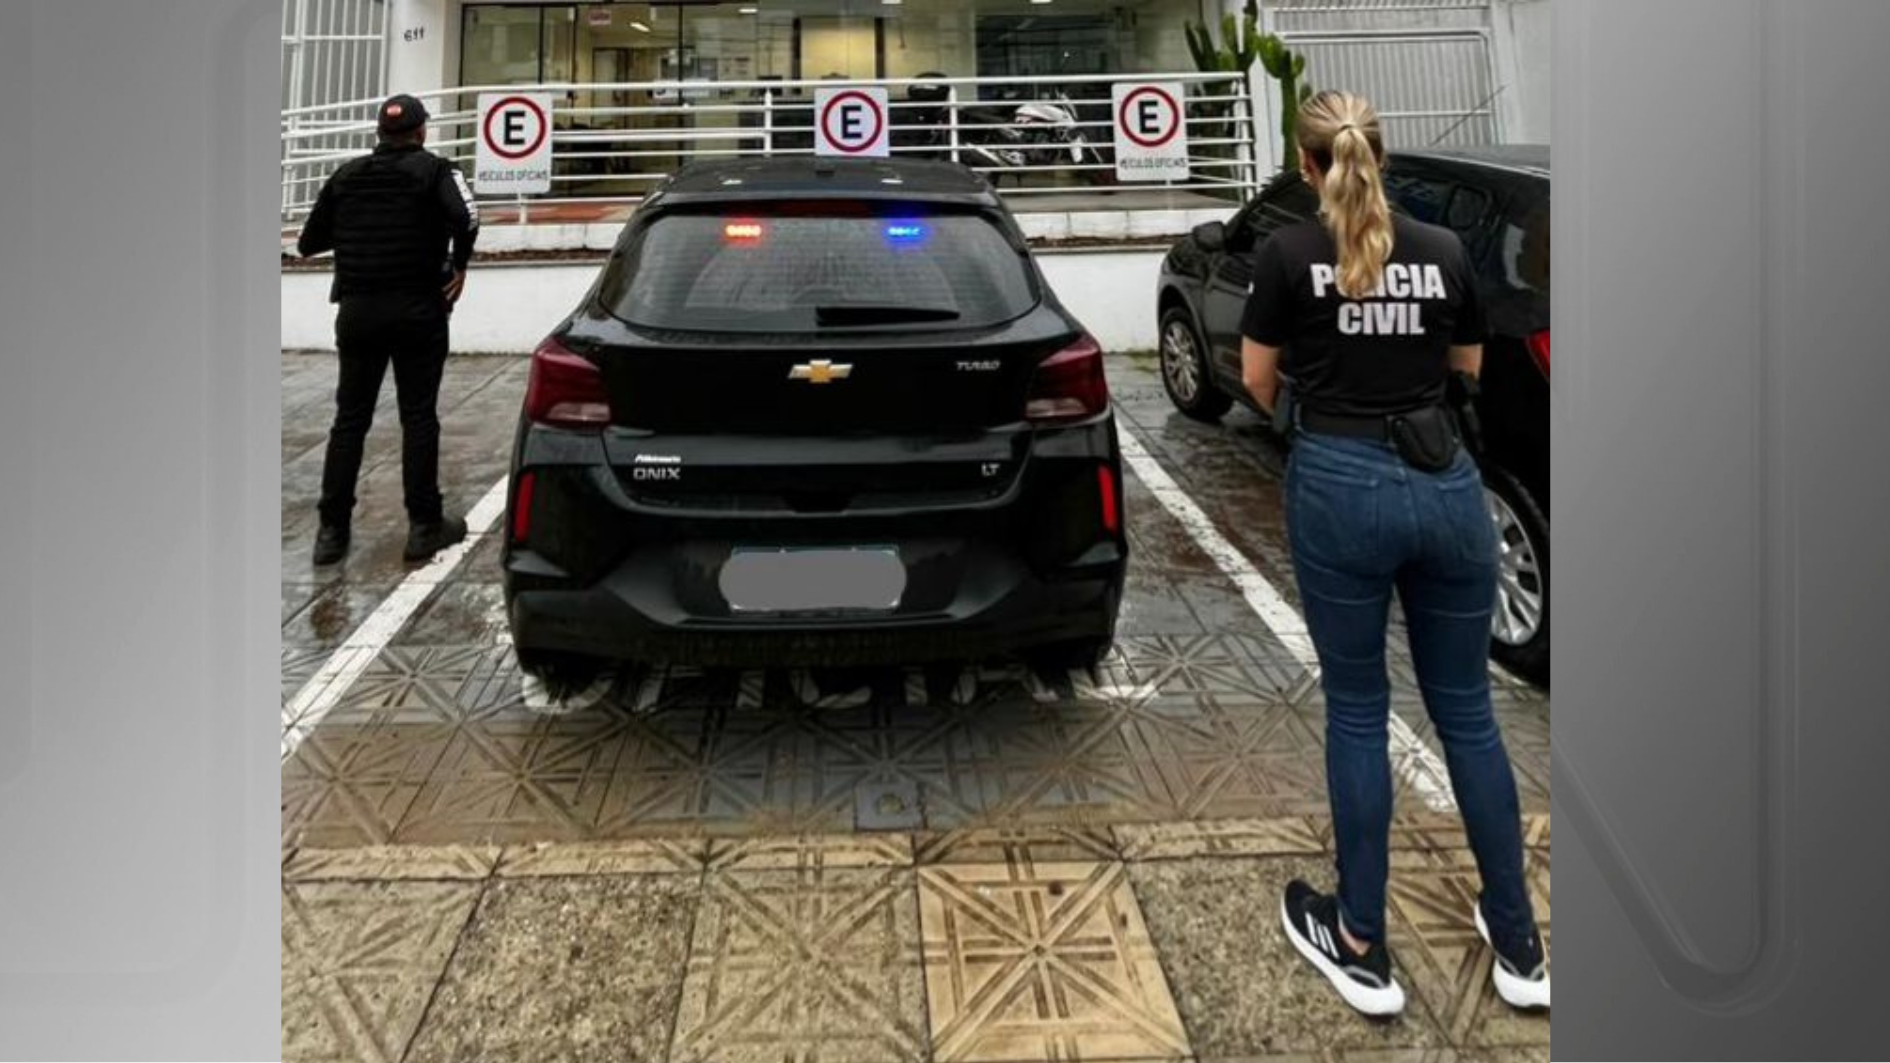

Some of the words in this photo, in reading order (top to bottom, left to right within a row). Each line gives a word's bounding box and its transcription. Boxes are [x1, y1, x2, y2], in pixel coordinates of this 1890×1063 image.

[504, 110, 526, 145] E
[841, 104, 862, 139] E
[1138, 100, 1160, 134] E
[1337, 302, 1425, 335] CIVIL
[633, 467, 681, 481] ONIX
[981, 463, 1000, 476] LT
